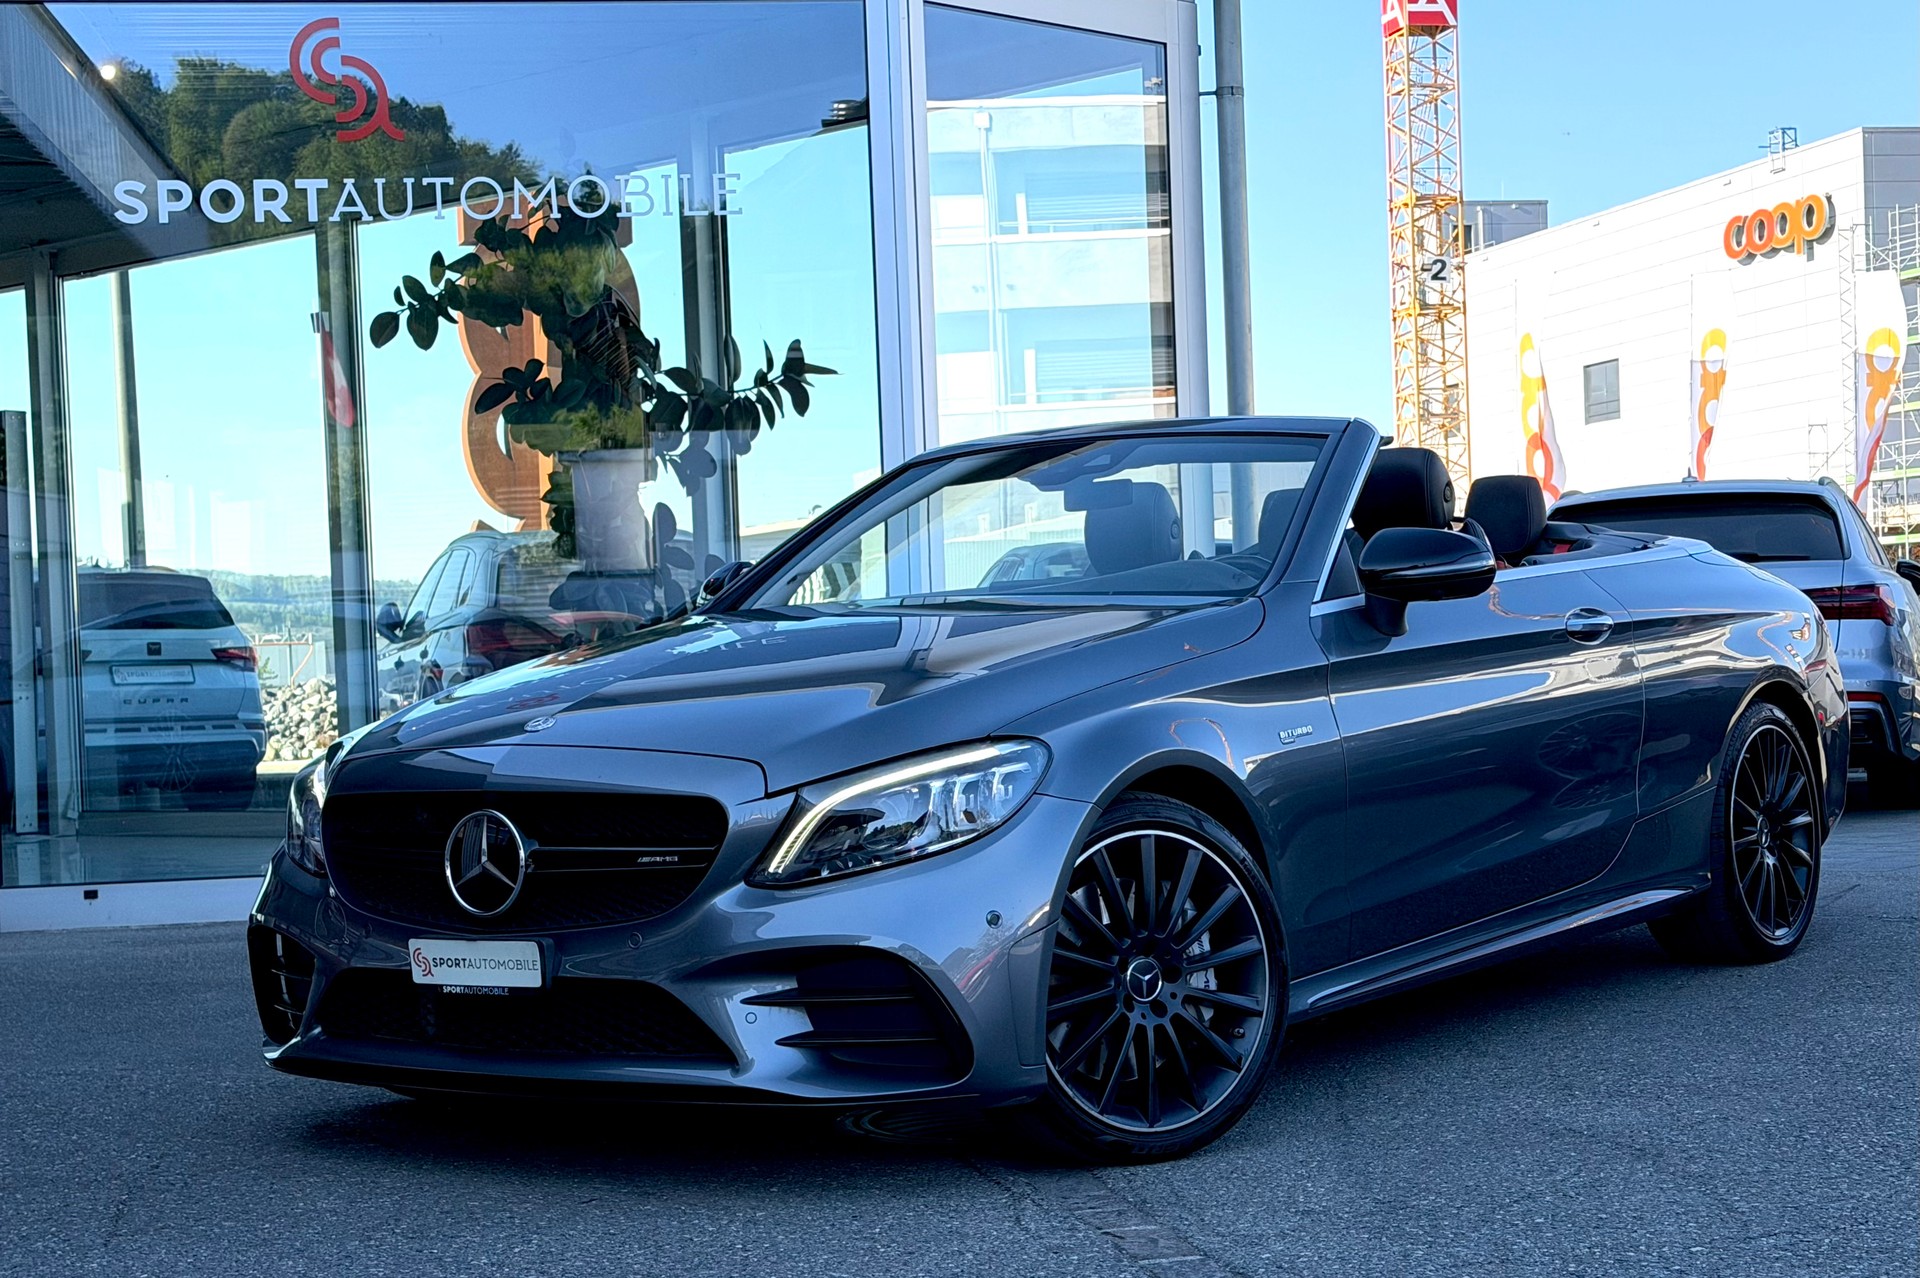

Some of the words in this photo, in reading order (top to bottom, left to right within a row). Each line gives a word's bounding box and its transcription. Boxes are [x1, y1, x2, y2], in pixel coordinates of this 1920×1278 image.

[113, 173, 743, 225] SPORTAUTOMOBILE
[1723, 194, 1826, 260] coop
[1430, 258, 1448, 281] 2
[1279, 724, 1313, 739] BITURBO
[646, 855, 679, 863] AMG
[432, 957, 539, 971] SPORTAUTOMOBILE
[442, 985, 510, 996] SPORTAUTOMOBILE
